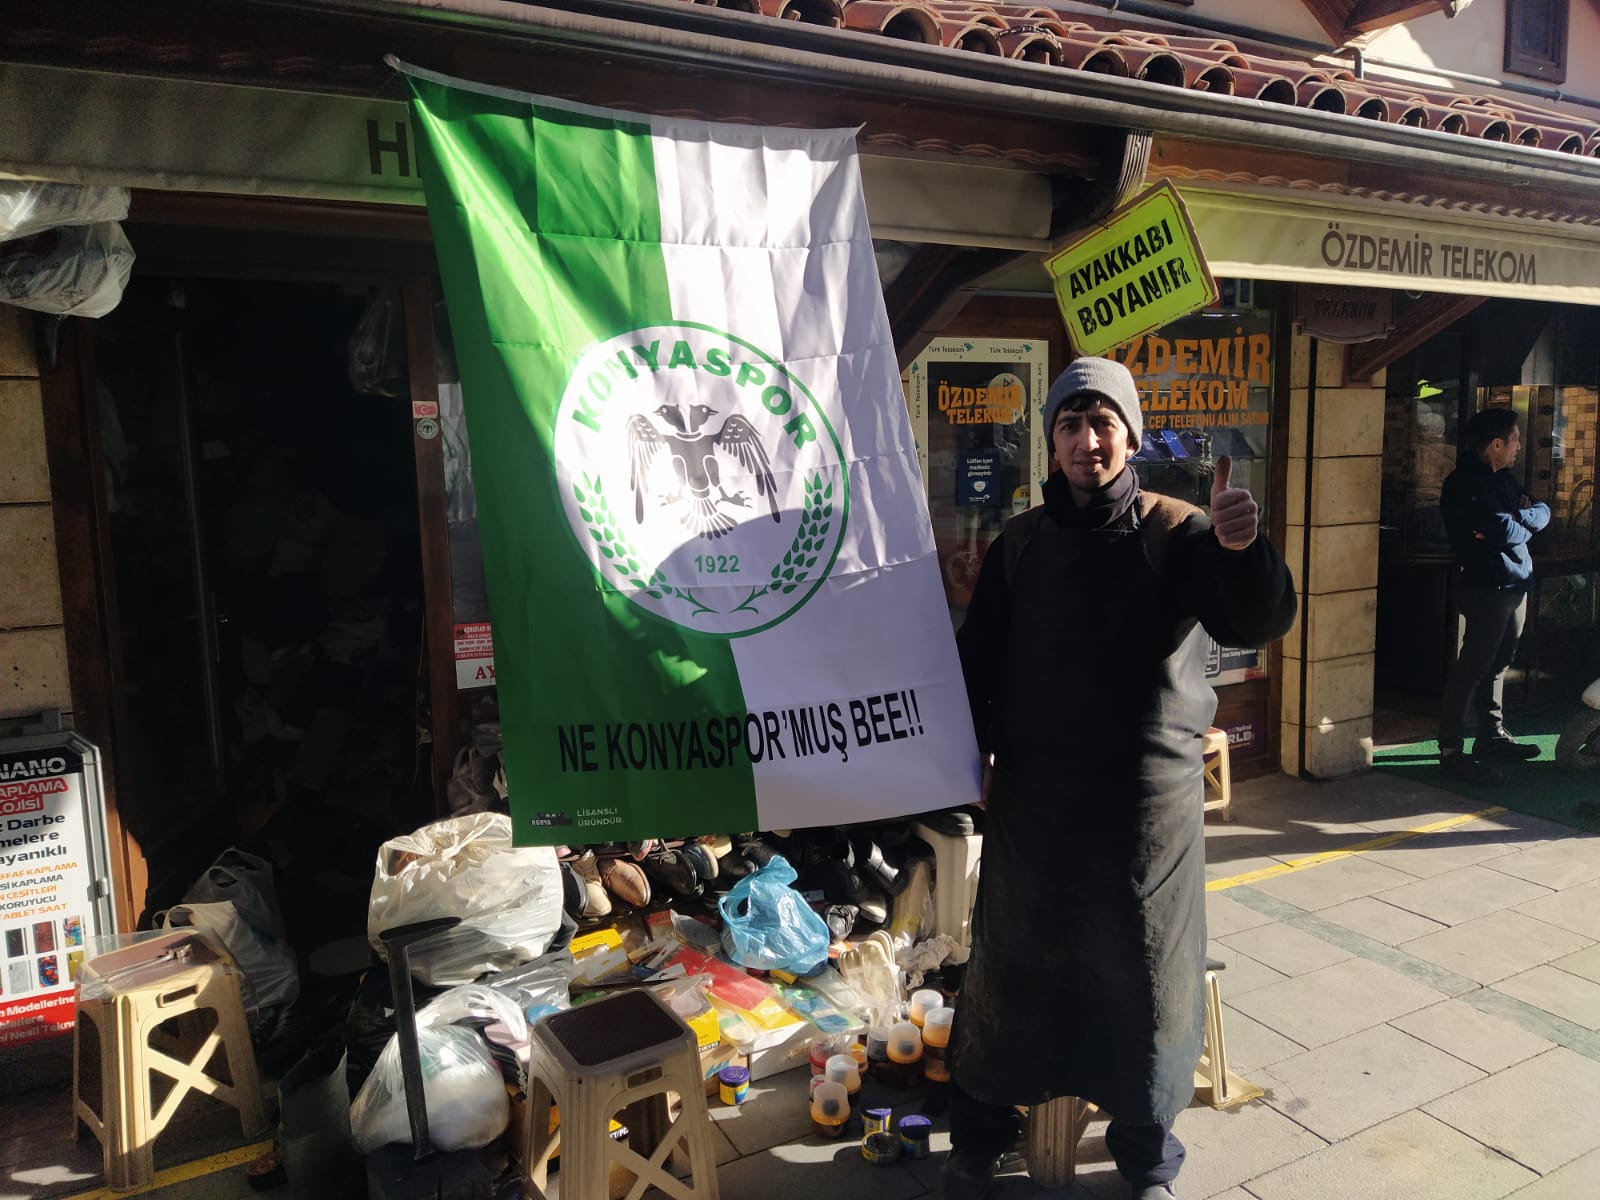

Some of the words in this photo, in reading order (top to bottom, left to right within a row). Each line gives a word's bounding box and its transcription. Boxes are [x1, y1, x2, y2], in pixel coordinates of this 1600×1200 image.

[366, 119, 420, 178] H
[1069, 218, 1173, 299] AYAKKABI
[1321, 222, 1433, 276] ÖZDEMİR
[1441, 244, 1537, 285] TELEKOM
[1077, 256, 1192, 336] BOYANIR
[571, 339, 818, 450] KONYASPOR
[938, 380, 1022, 411] ÖZDEMİR
[1149, 415, 1167, 429] CEP
[1170, 413, 1215, 428] TELEFONU
[1218, 412, 1238, 426] ALIM
[694, 555, 741, 574] 1922
[558, 724, 599, 772] NE
[606, 703, 848, 771] KONYASPOR'MUŞ
[849, 689, 924, 747] BEE!!
[0, 797, 40, 814] OJİSİ
[577, 808, 618, 817] LİSANSLI
[7, 814, 66, 831] Darbe
[0, 831, 60, 848] melere
[26, 862, 79, 875] KAPLAMA
[11, 874, 64, 888] KAPLAMA
[0, 895, 57, 911] KORUYUCU
[0, 908, 36, 920] ABLET
[38, 903, 68, 914] SAAT
[6, 995, 76, 1017] Modellerine
[10, 1027, 39, 1040] Nesil
